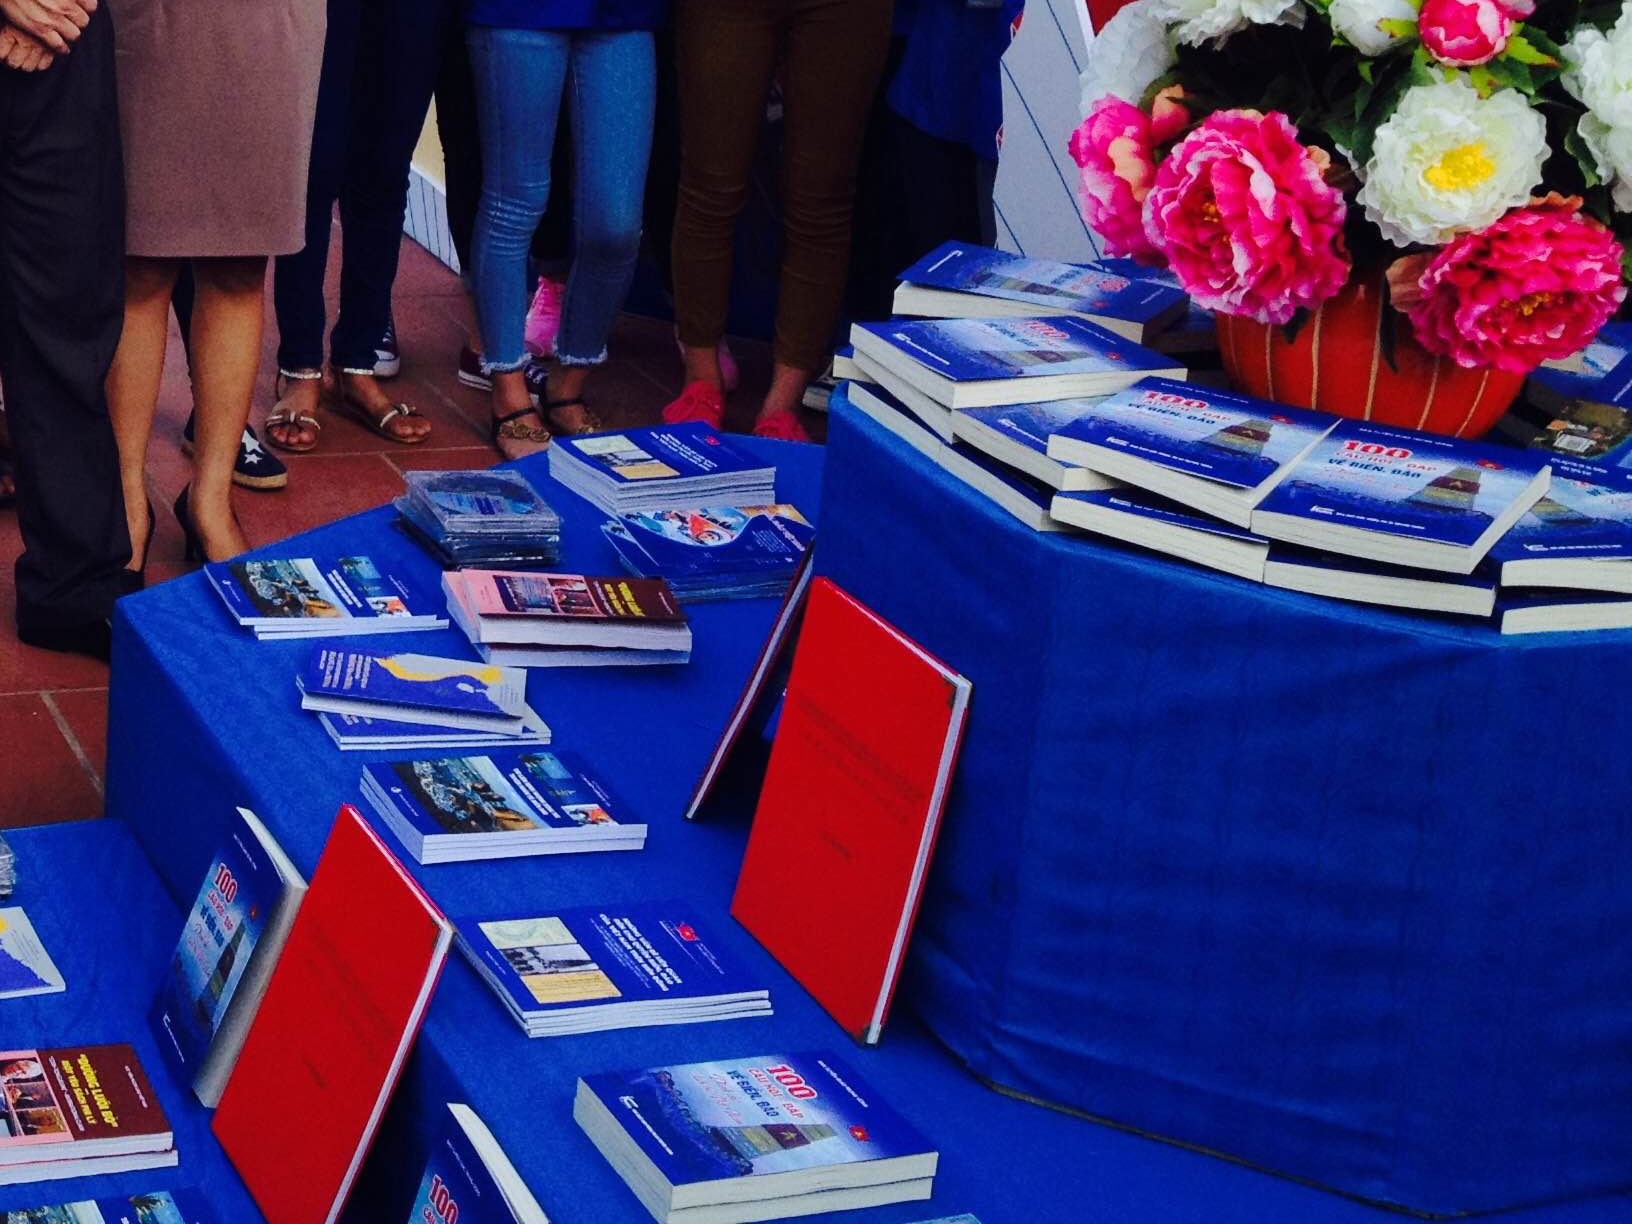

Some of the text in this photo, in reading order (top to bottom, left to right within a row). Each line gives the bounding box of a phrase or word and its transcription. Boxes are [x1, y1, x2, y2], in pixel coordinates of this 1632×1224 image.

[1145, 390, 1211, 410] 100
[1343, 439, 1414, 460] 100
[213, 862, 237, 904] 100
[766, 1064, 817, 1099] 100
[428, 1173, 459, 1224] 100
